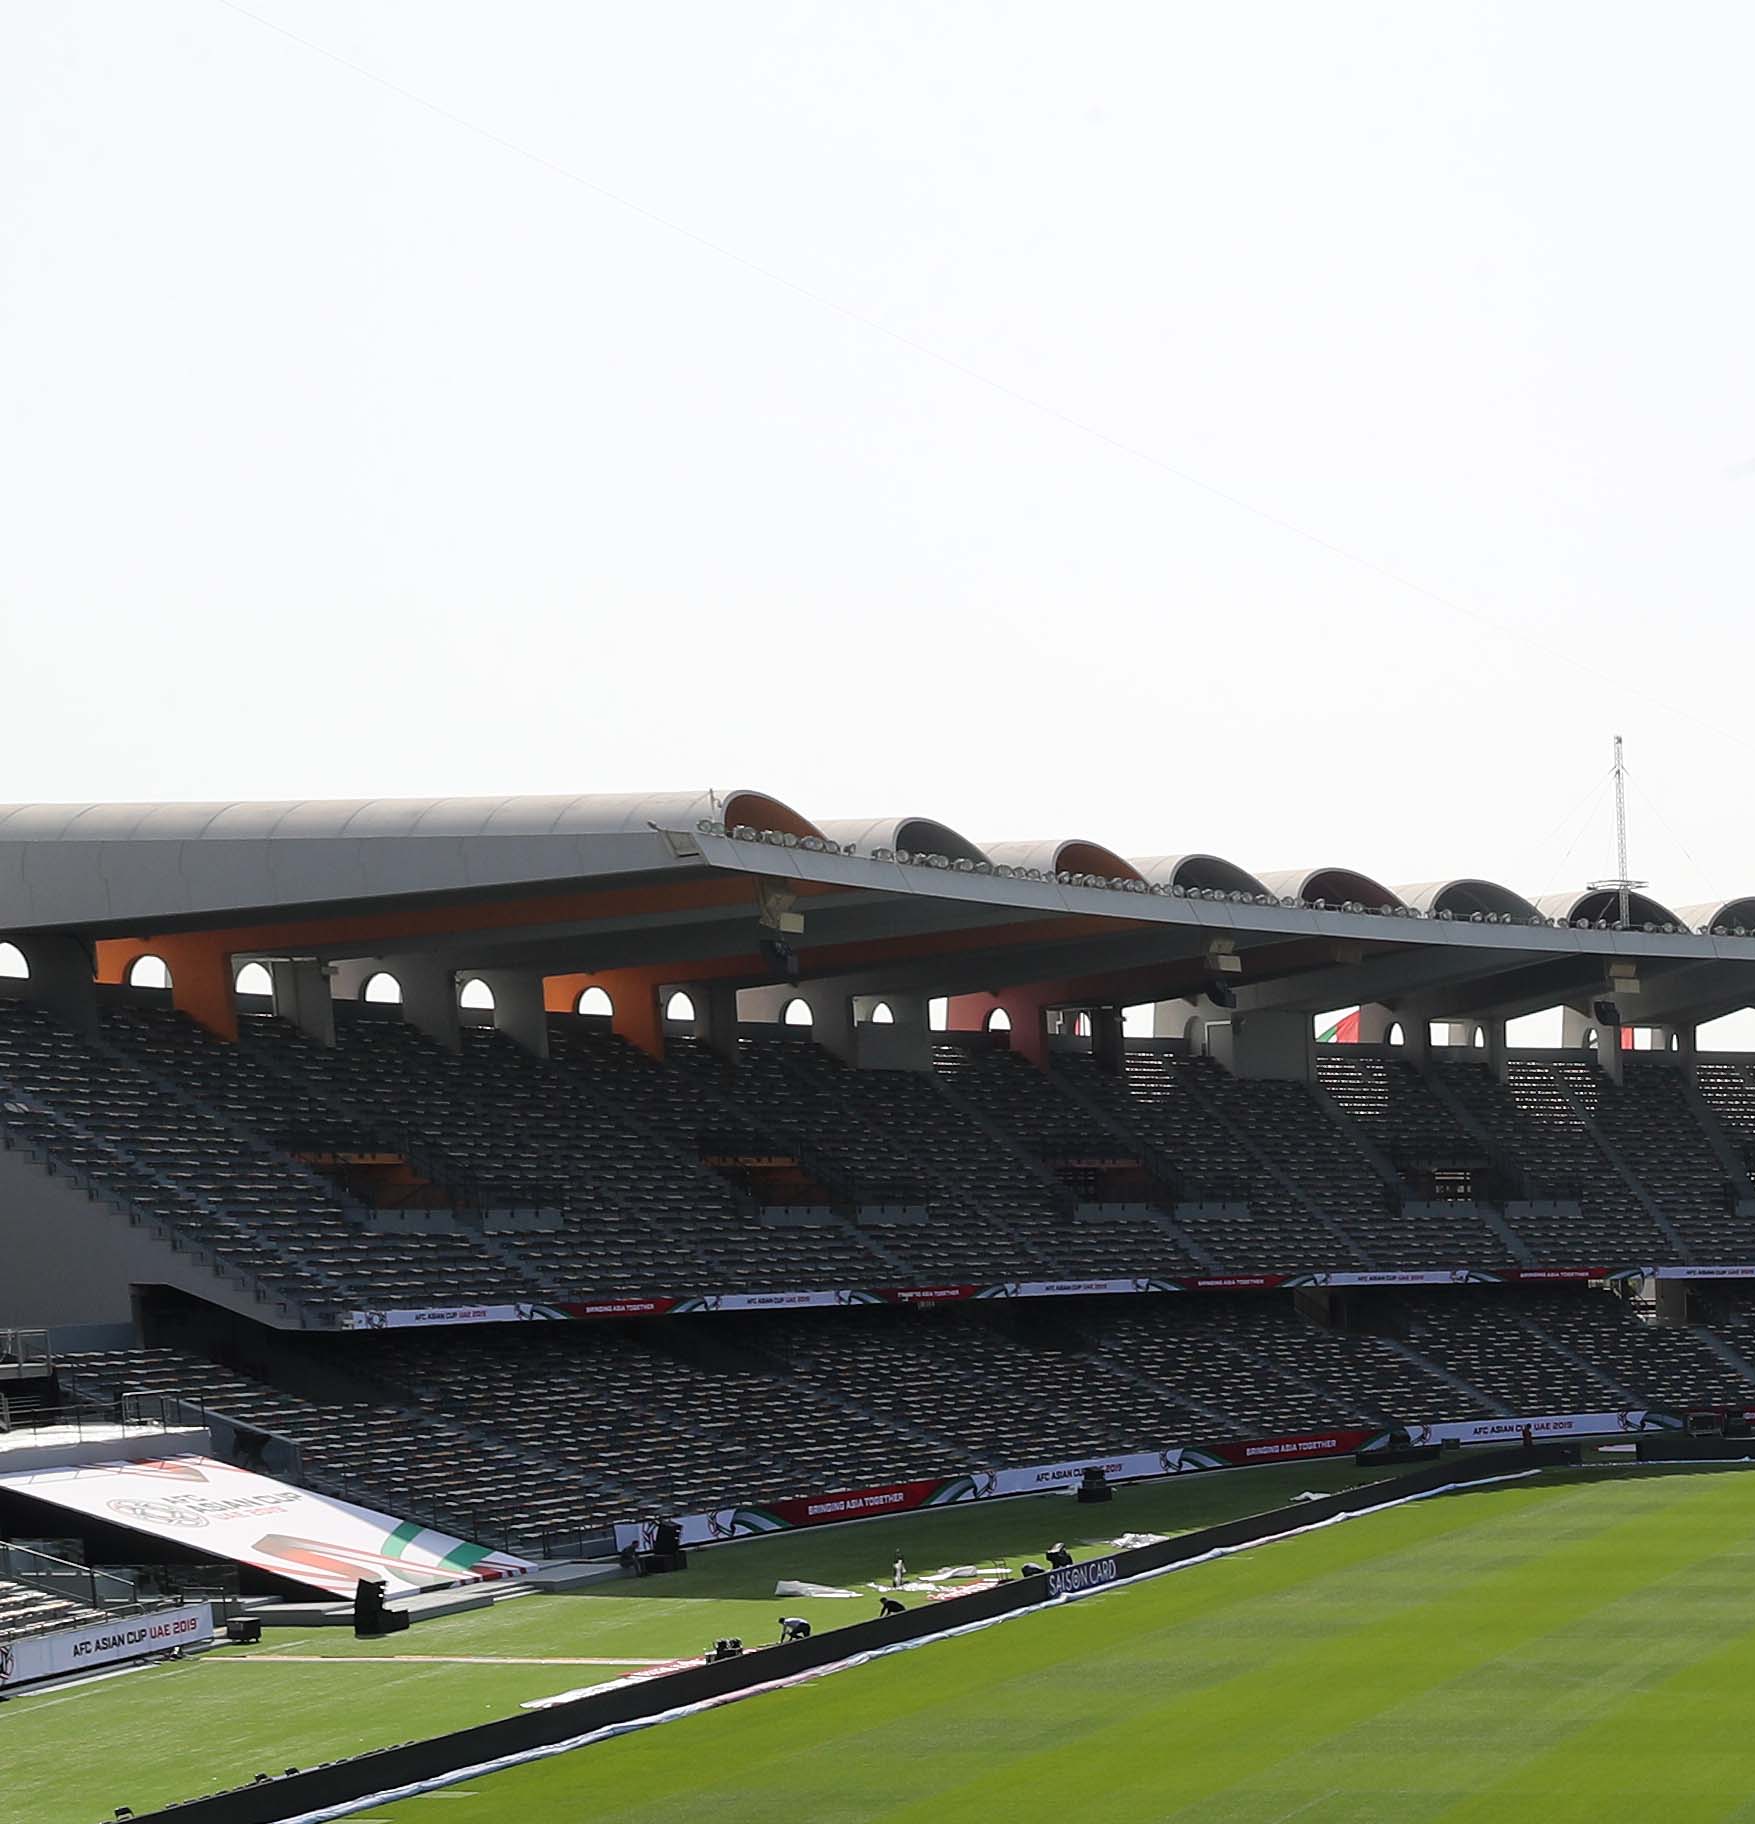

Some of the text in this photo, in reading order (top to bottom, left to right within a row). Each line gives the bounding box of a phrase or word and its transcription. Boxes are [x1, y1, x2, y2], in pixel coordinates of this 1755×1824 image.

[1472, 1427, 1488, 1435] AFC
[1490, 1426, 1515, 1434] ASIAN
[1280, 1443, 1297, 1453] ASIA
[1298, 1440, 1337, 1451] TOGETHER
[1036, 1471, 1050, 1482] AFC
[808, 1493, 904, 1515] BRINGING ASIA TOGETHER
[1049, 1559, 1117, 1596] SAISON CARD
[73, 1618, 197, 1658] AFC ASIAN CUP UAE 2019
